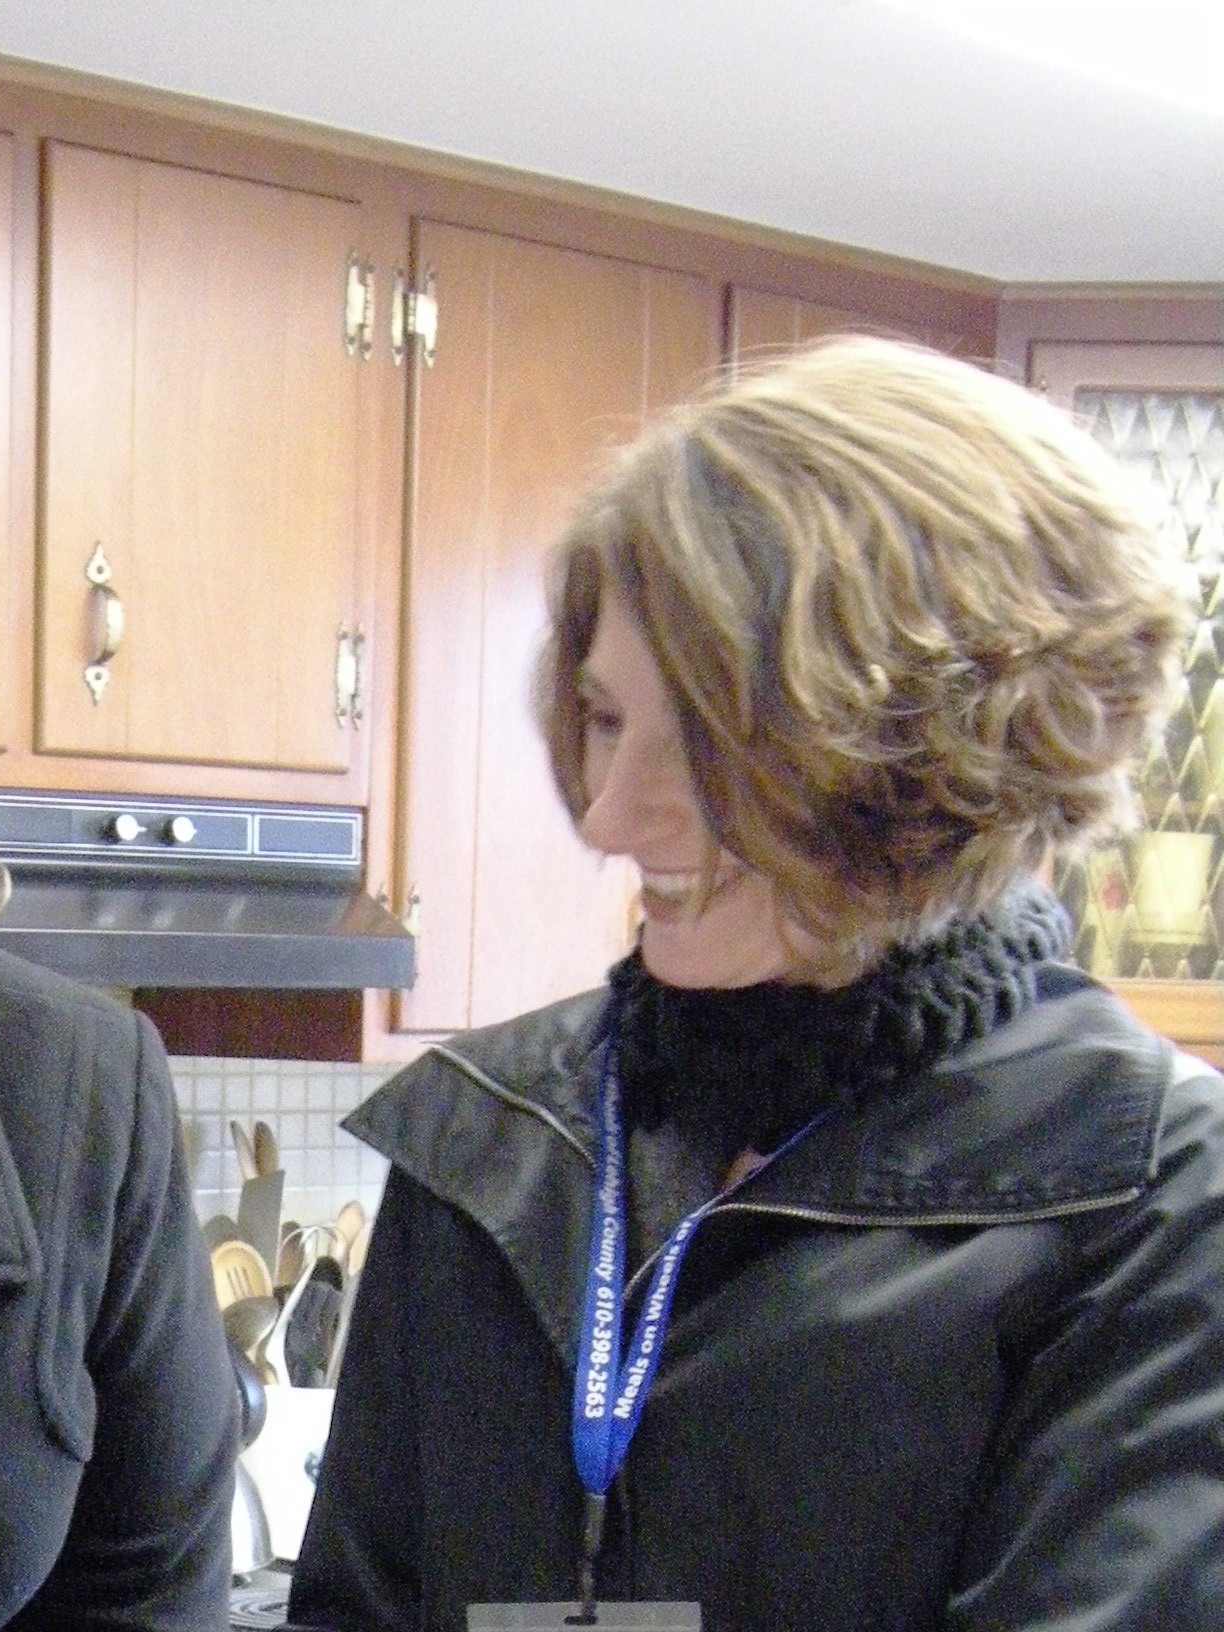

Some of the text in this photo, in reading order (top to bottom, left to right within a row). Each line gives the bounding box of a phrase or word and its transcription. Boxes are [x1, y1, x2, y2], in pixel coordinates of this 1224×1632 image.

[595, 1216, 620, 1281] County
[645, 1245, 680, 1322] Wheels
[584, 1286, 616, 1419] 610-398-2563
[641, 1324, 658, 1354] on
[613, 1357, 650, 1419] Meals
